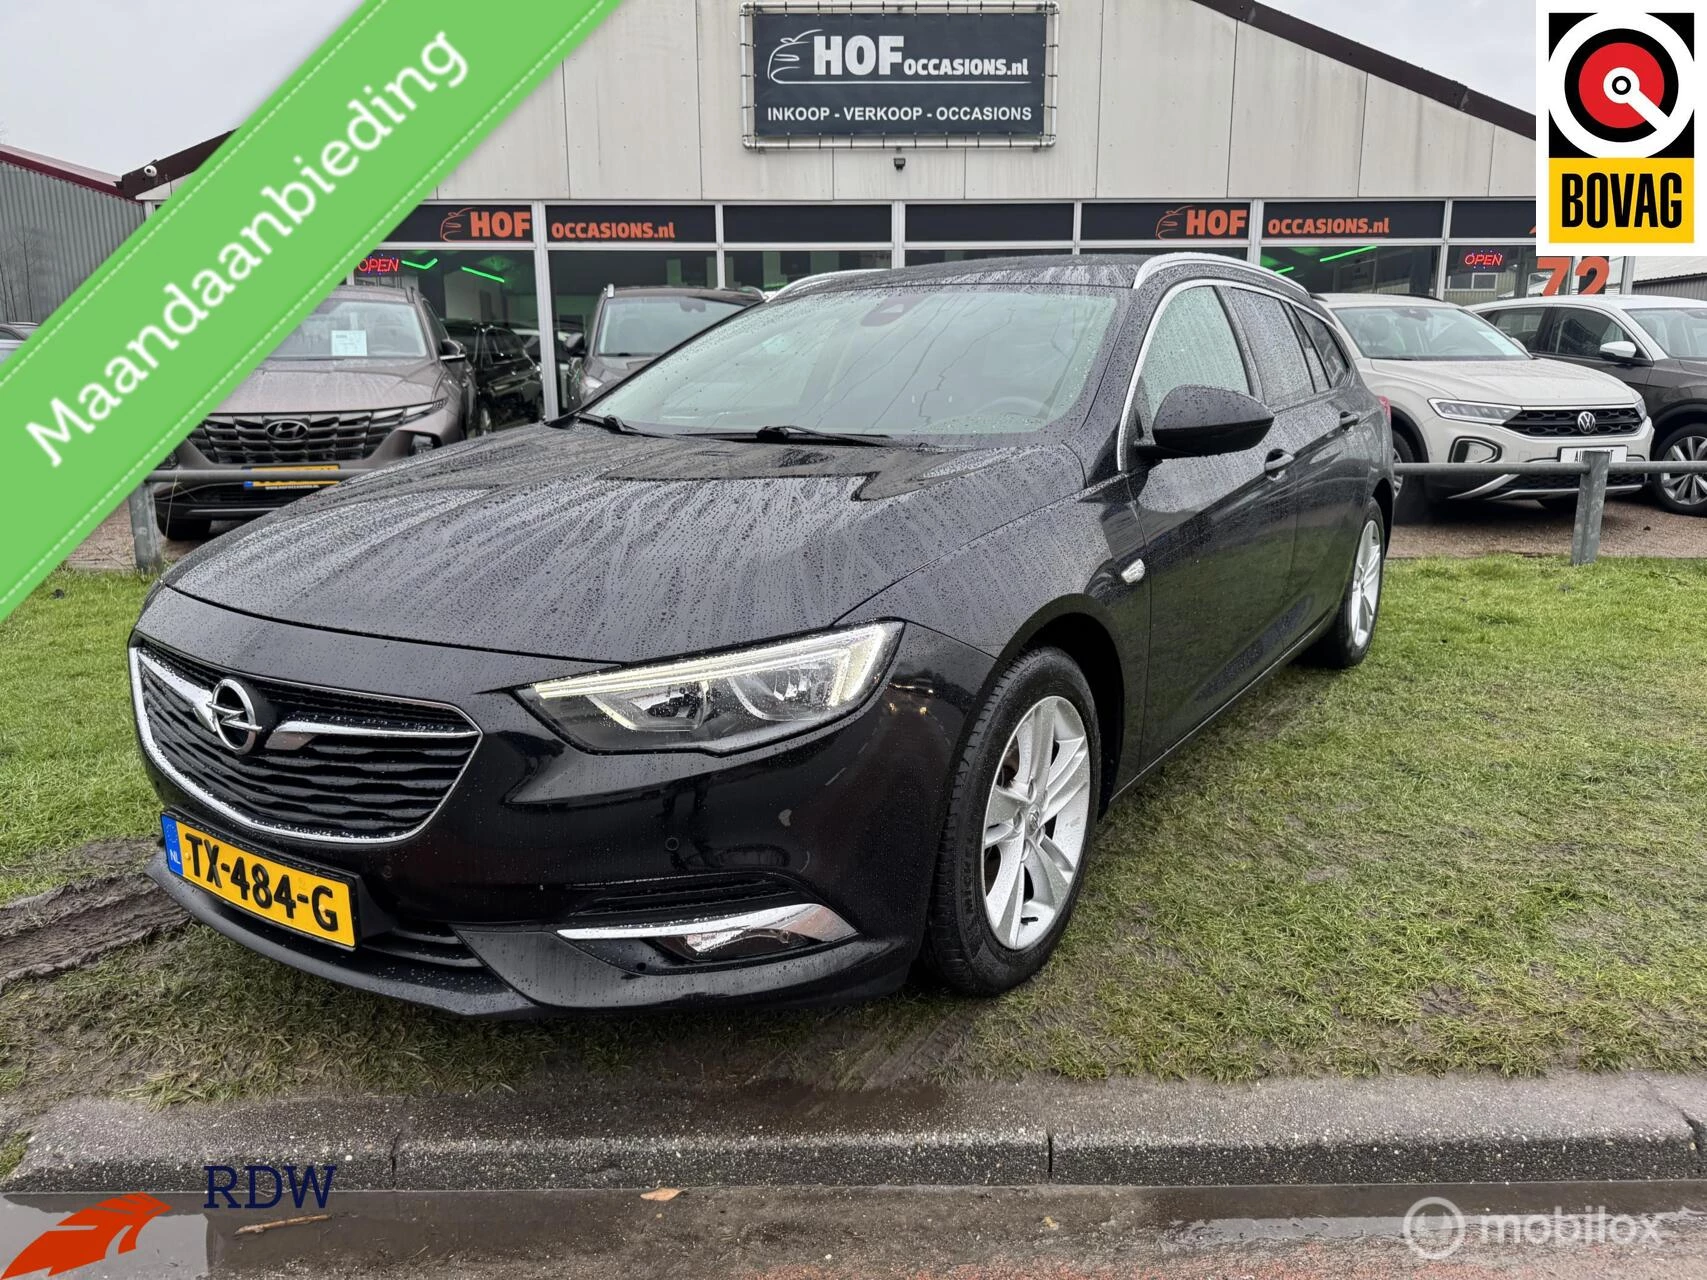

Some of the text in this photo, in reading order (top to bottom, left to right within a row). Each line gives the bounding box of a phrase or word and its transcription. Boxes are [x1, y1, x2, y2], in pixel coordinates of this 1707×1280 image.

[813, 35, 904, 75] HOF
[767, 107, 830, 121] INKOOP
[843, 107, 923, 121] VERKOOP
[936, 107, 1032, 121] OCCASIONS
[470, 211, 675, 239] HOF OCCASIONS.nl
[1185, 209, 1390, 236] HOF OCCASIONS.nl
[357, 258, 399, 273] OPEN
[1464, 254, 1503, 266] OPEN
[1536, 256, 1609, 296] 72
[169, 849, 181, 865] NL
[185, 833, 339, 932] TX-484-G
